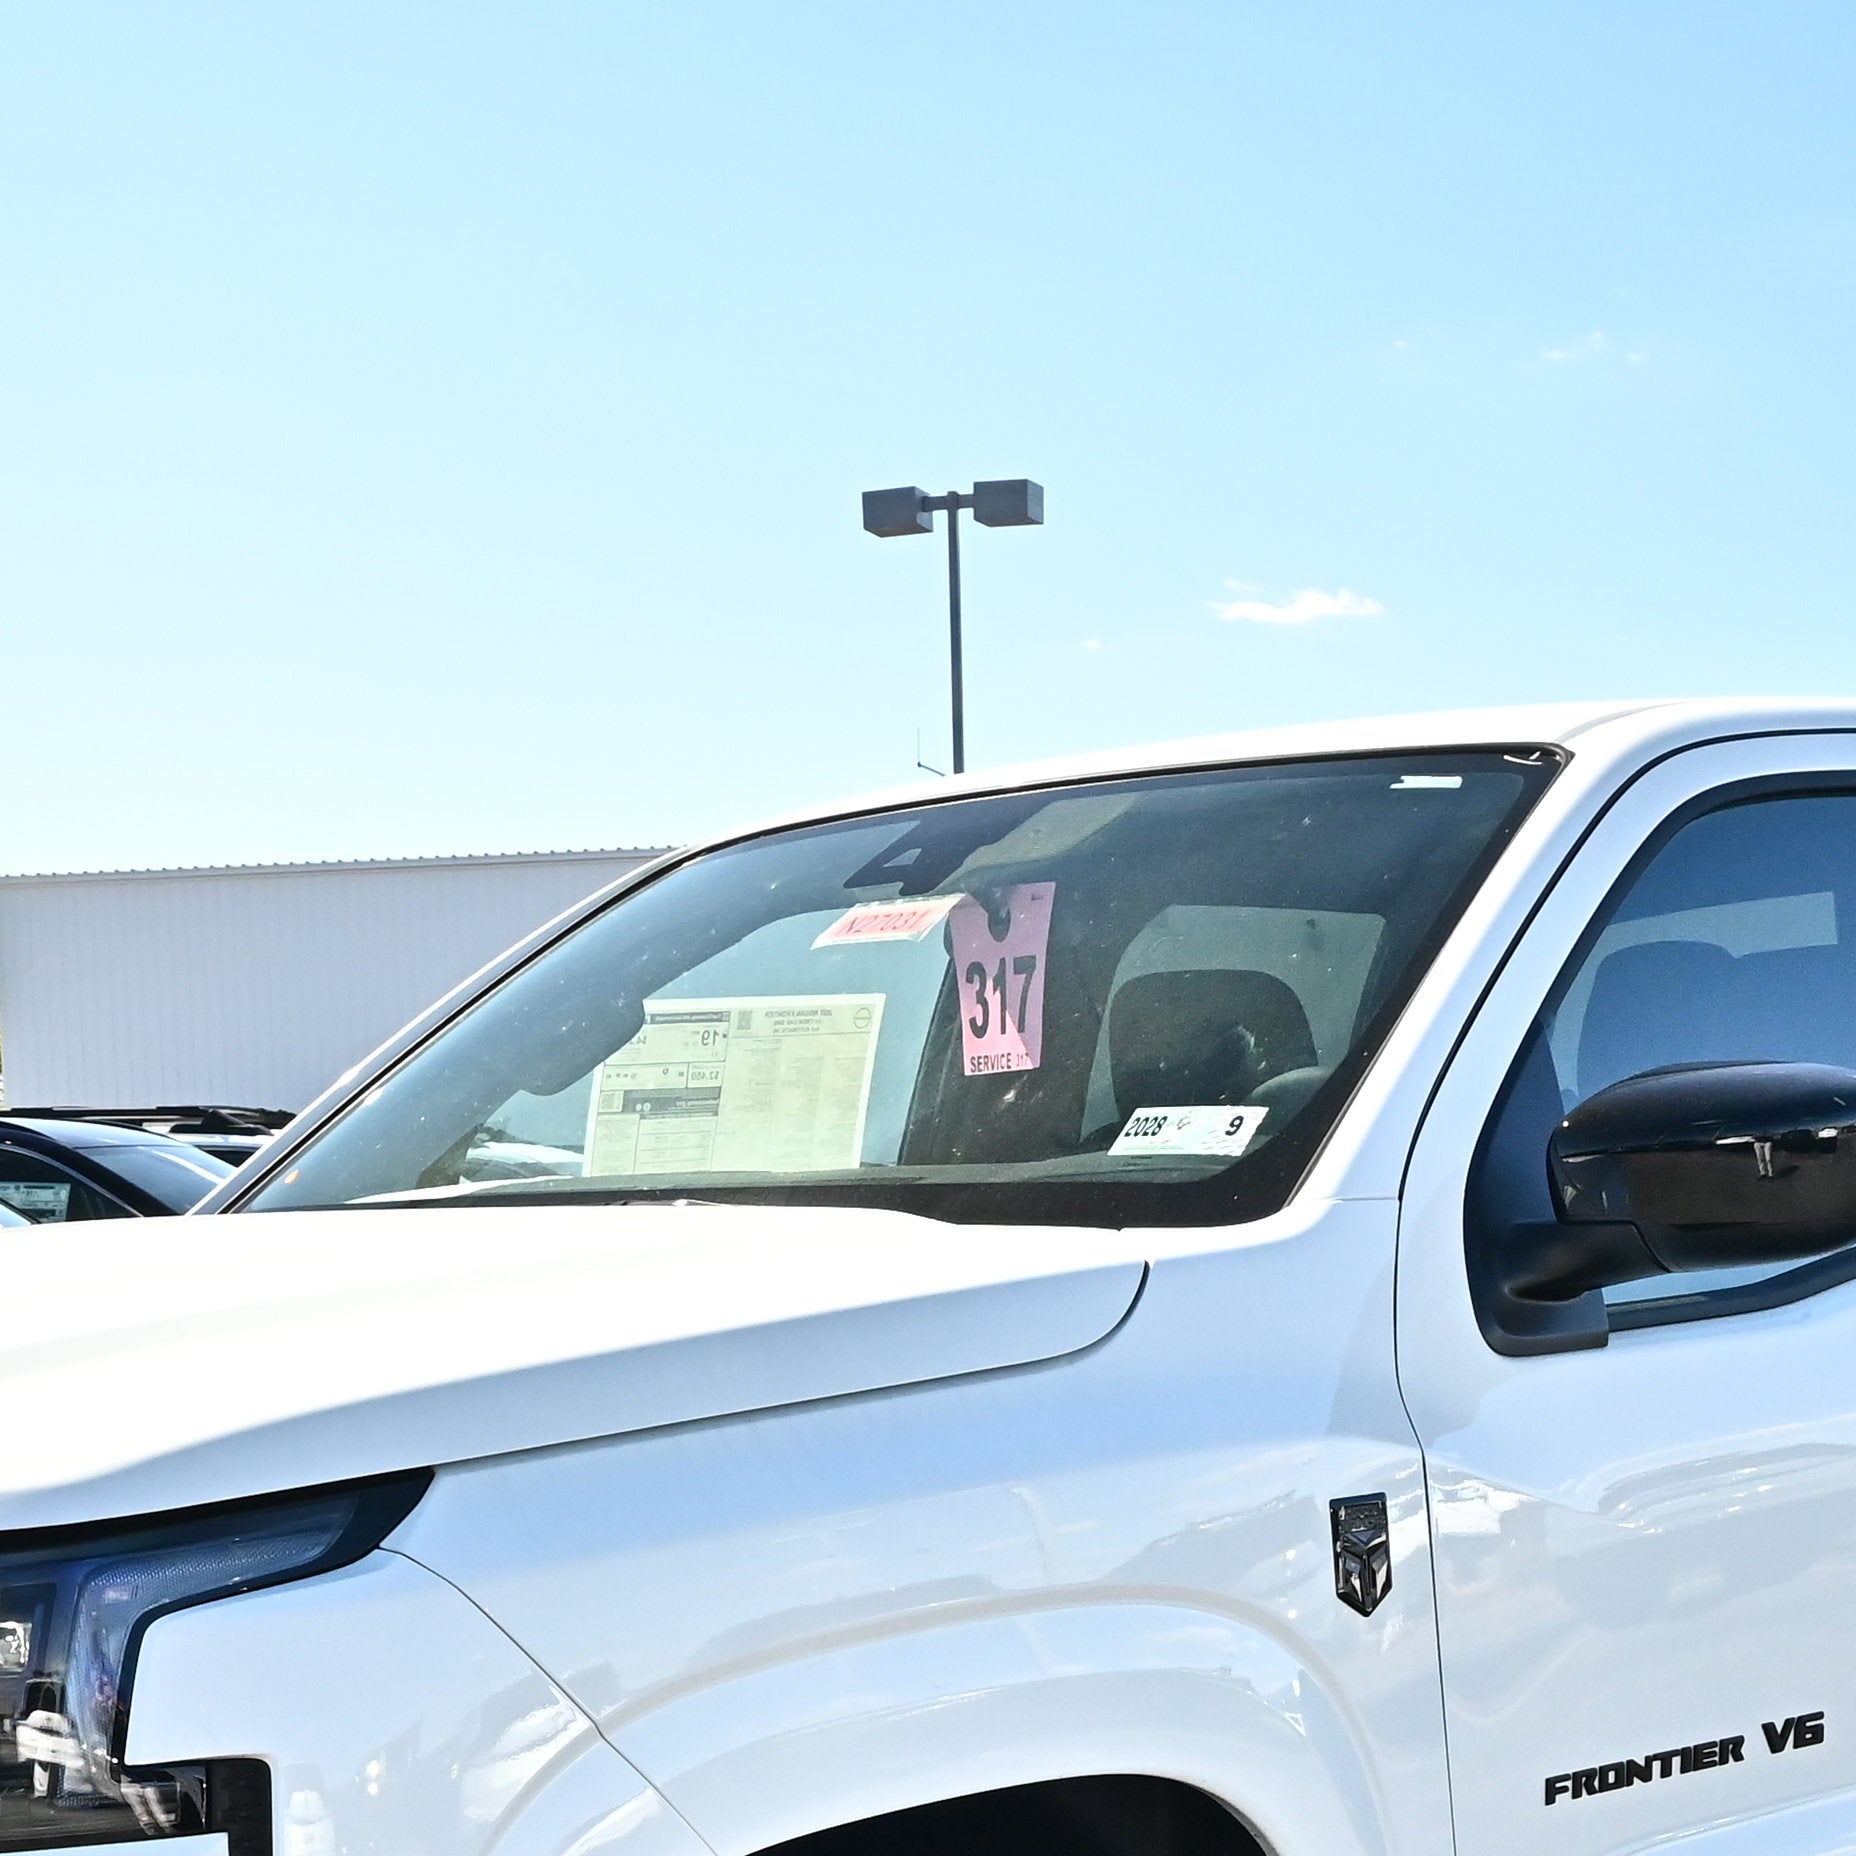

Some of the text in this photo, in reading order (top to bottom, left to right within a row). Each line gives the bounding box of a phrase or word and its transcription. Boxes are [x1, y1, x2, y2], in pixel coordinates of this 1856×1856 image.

[845, 910, 929, 936] N27031
[965, 955, 1037, 1039] 317
[970, 1052, 1012, 1073] SERVICE
[1124, 1115, 1245, 1137] 2028 9
[1544, 1711, 1825, 1806] FRONTIER V6
